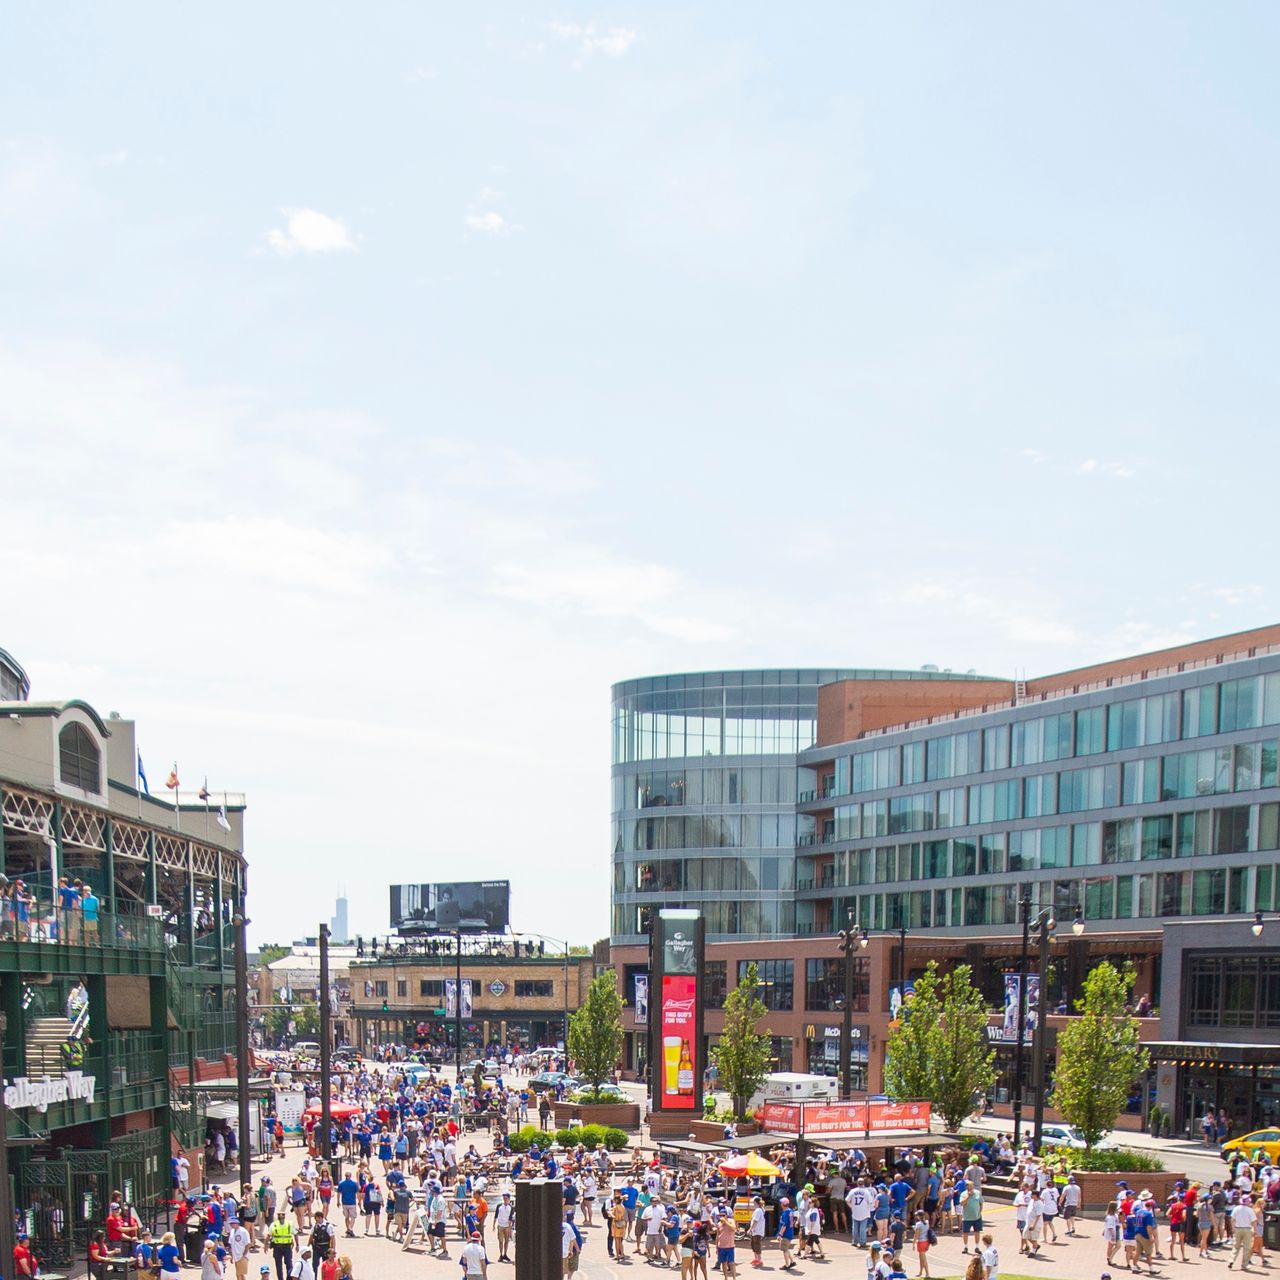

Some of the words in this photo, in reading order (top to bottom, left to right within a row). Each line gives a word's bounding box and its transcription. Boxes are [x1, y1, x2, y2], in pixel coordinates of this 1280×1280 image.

[665, 939, 693, 947] Gallagher
[673, 945, 686, 953] Way
[824, 1027, 861, 1038] McDd's
[1156, 1046, 1221, 1060] ZACHARY
[3, 1075, 68, 1114] allagher
[63, 1070, 97, 1104] Way
[807, 1122, 820, 1131] THIS
[821, 1122, 839, 1131] BUD'S
[839, 1121, 851, 1130] FOR
[872, 1120, 885, 1129] THIS
[885, 1120, 902, 1129] BUD'S
[902, 1119, 914, 1127] FOR
[854, 1196, 864, 1206] 17
